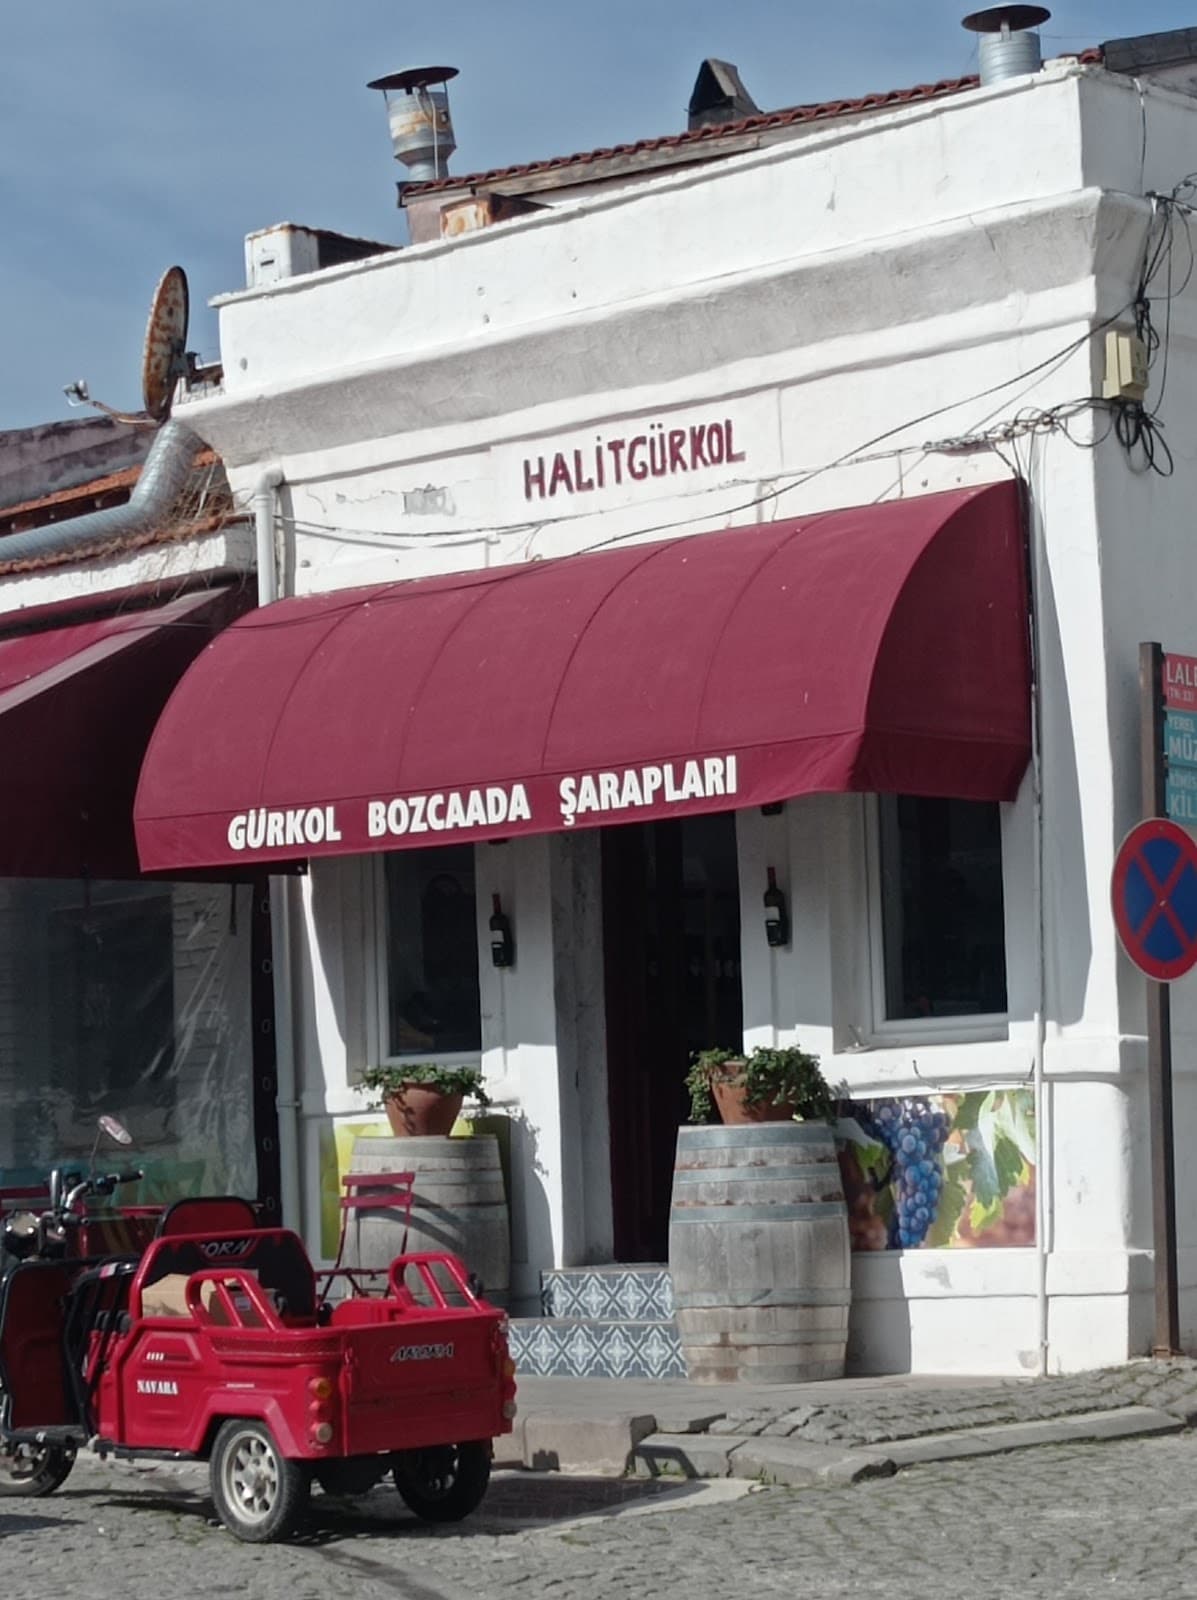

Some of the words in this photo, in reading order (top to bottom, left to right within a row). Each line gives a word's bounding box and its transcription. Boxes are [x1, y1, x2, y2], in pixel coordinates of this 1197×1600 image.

[523, 419, 746, 501] HALİTGÜRKOL
[227, 806, 341, 850] GÜRKOL
[367, 784, 531, 837] BOZCAADA
[559, 755, 737, 826] ŞARAPLARI
[137, 1380, 178, 1395] NAVARA
